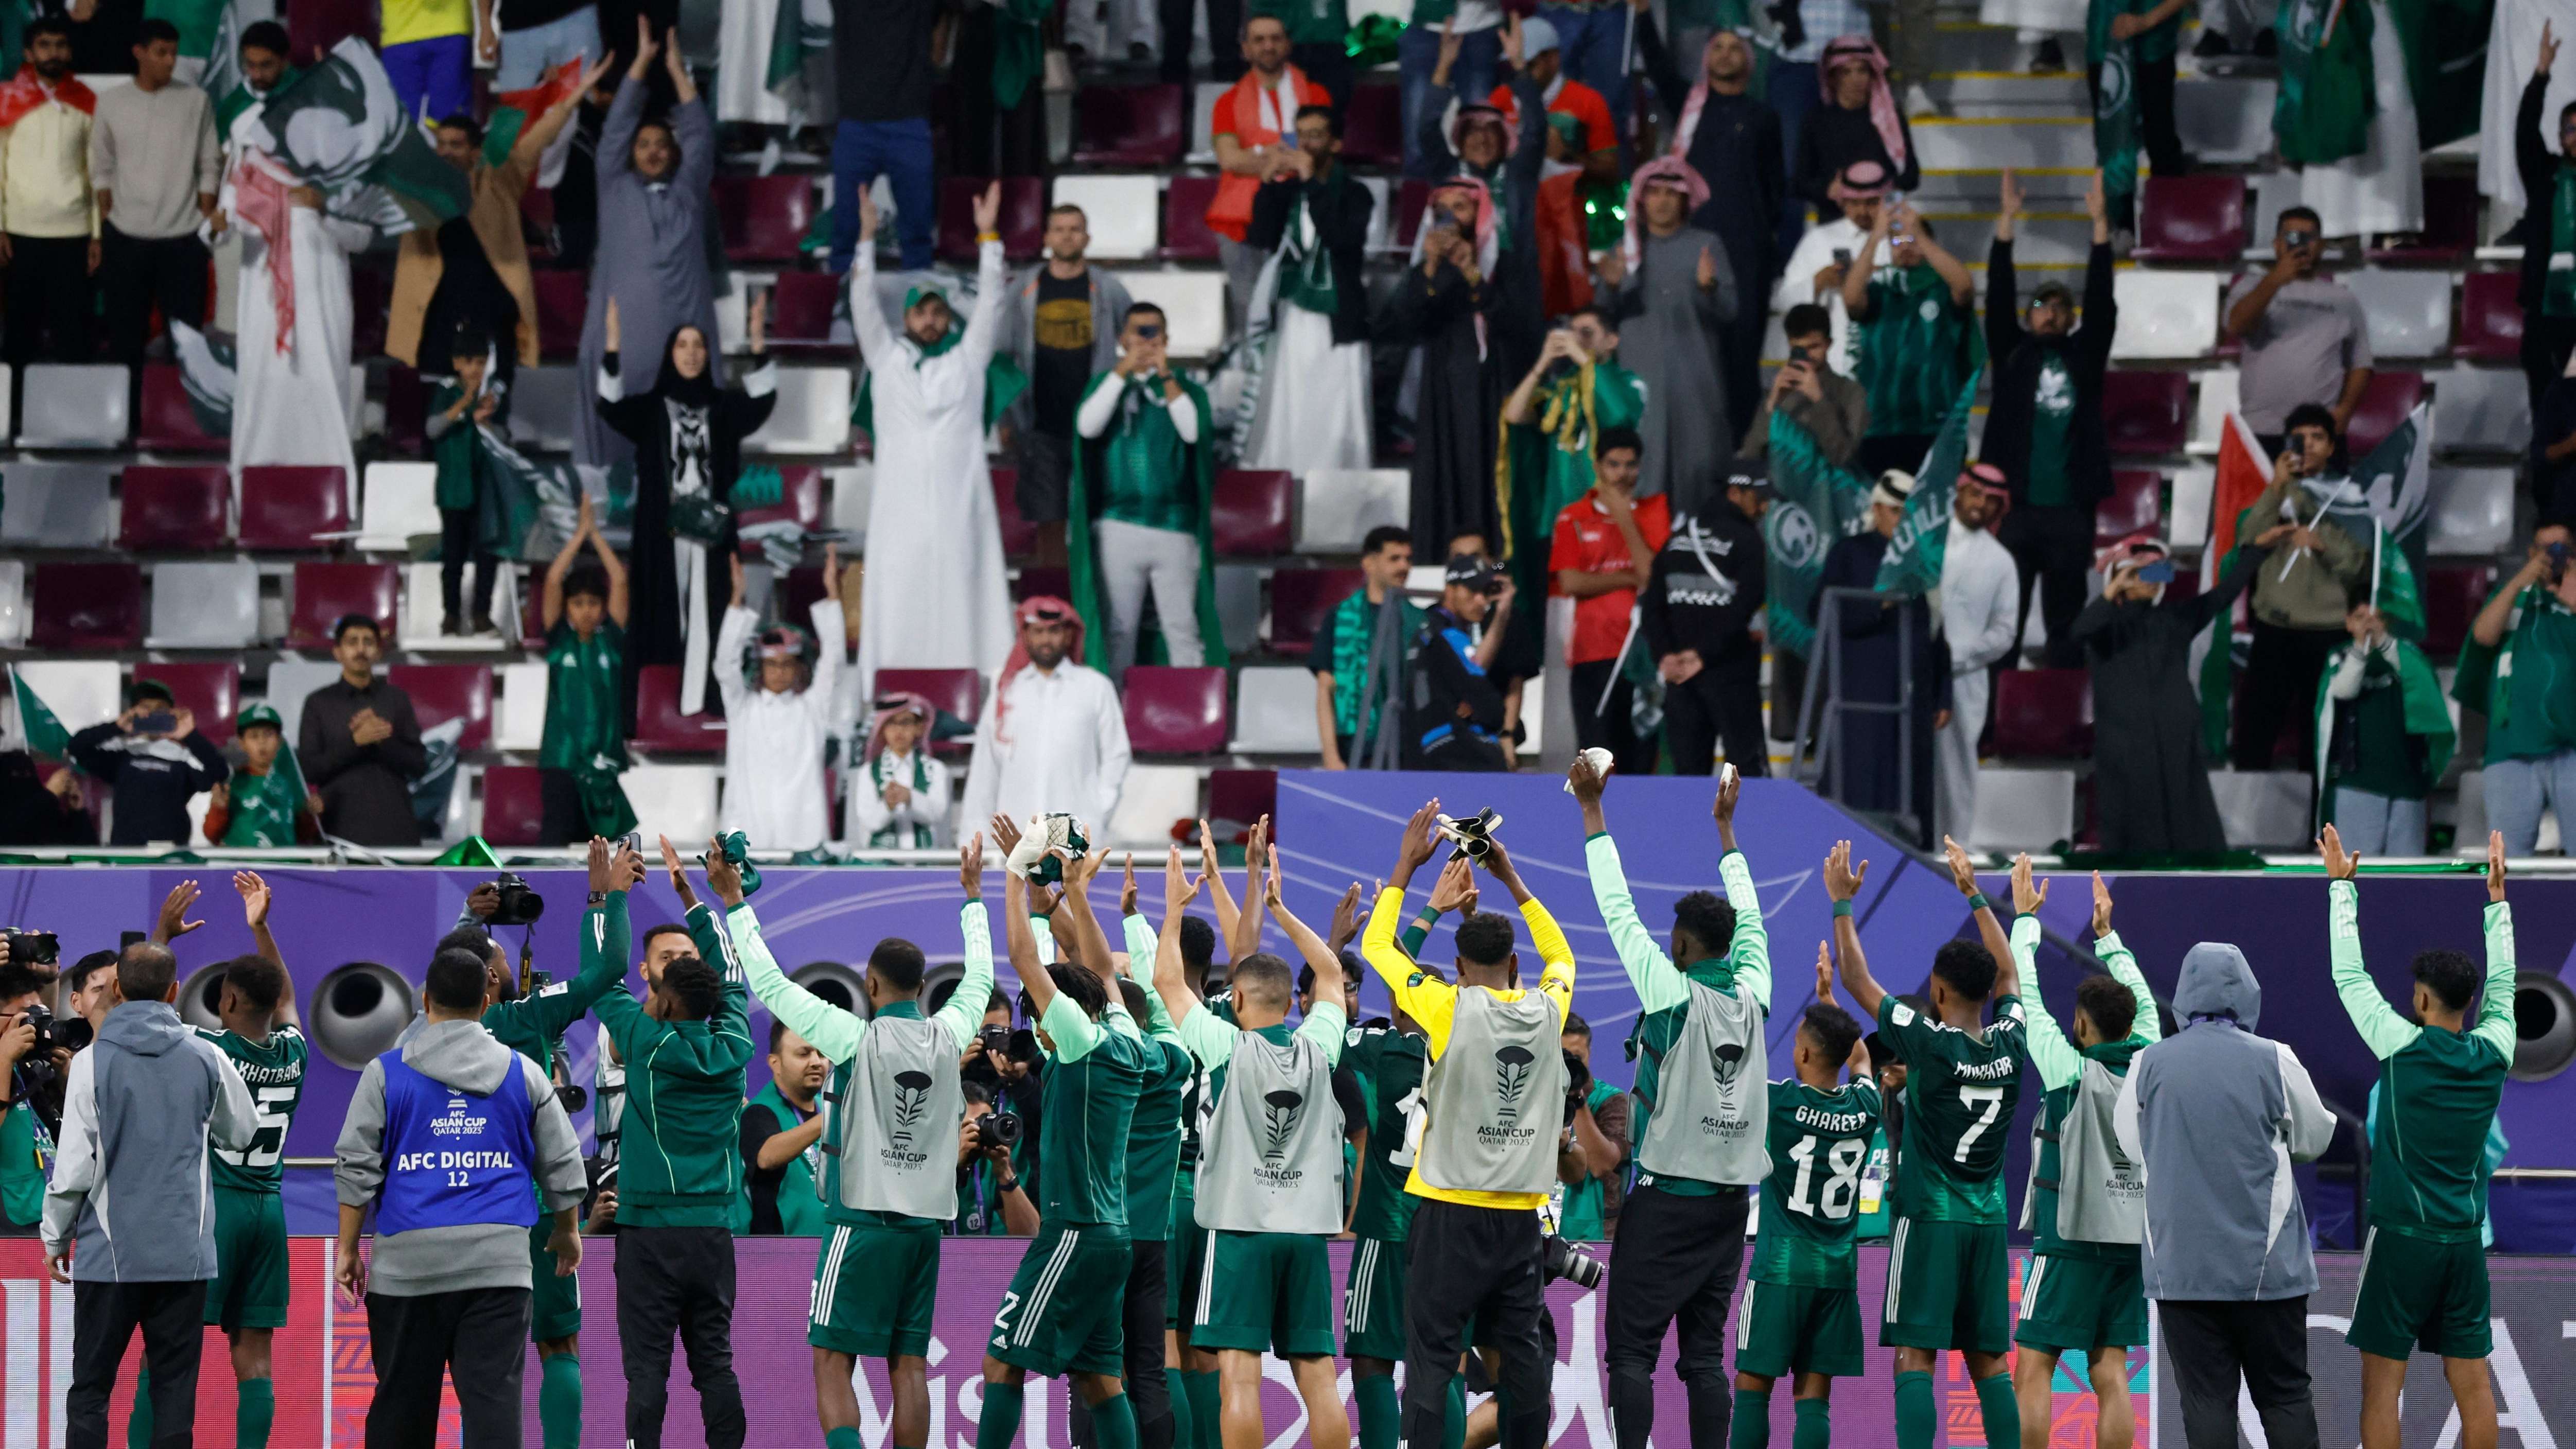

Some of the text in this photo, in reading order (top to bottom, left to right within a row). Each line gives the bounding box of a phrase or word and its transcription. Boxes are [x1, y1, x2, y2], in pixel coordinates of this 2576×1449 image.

[430, 1118, 486, 1127] ASIAN CUP
[1701, 1116, 1749, 1130] ASIAN CUP
[1795, 1105, 1867, 1132] GHAREEB
[1954, 1085, 2004, 1162] 7
[433, 1127, 461, 1136] QATAR
[1477, 1126, 1535, 1138] ASIAN CUP
[1479, 1136, 1506, 1146] QATAR
[396, 1151, 513, 1171] AFC DIGITAL
[881, 1148, 927, 1163] ASIAN CUP
[448, 1171, 469, 1187] 12
[1254, 1167, 1302, 1180] ASIAN CUP
[1787, 1134, 1867, 1219] 18
[1256, 1177, 1276, 1188] QATAR
[969, 1218, 979, 1228] 12
[995, 1290, 1020, 1330] 2
